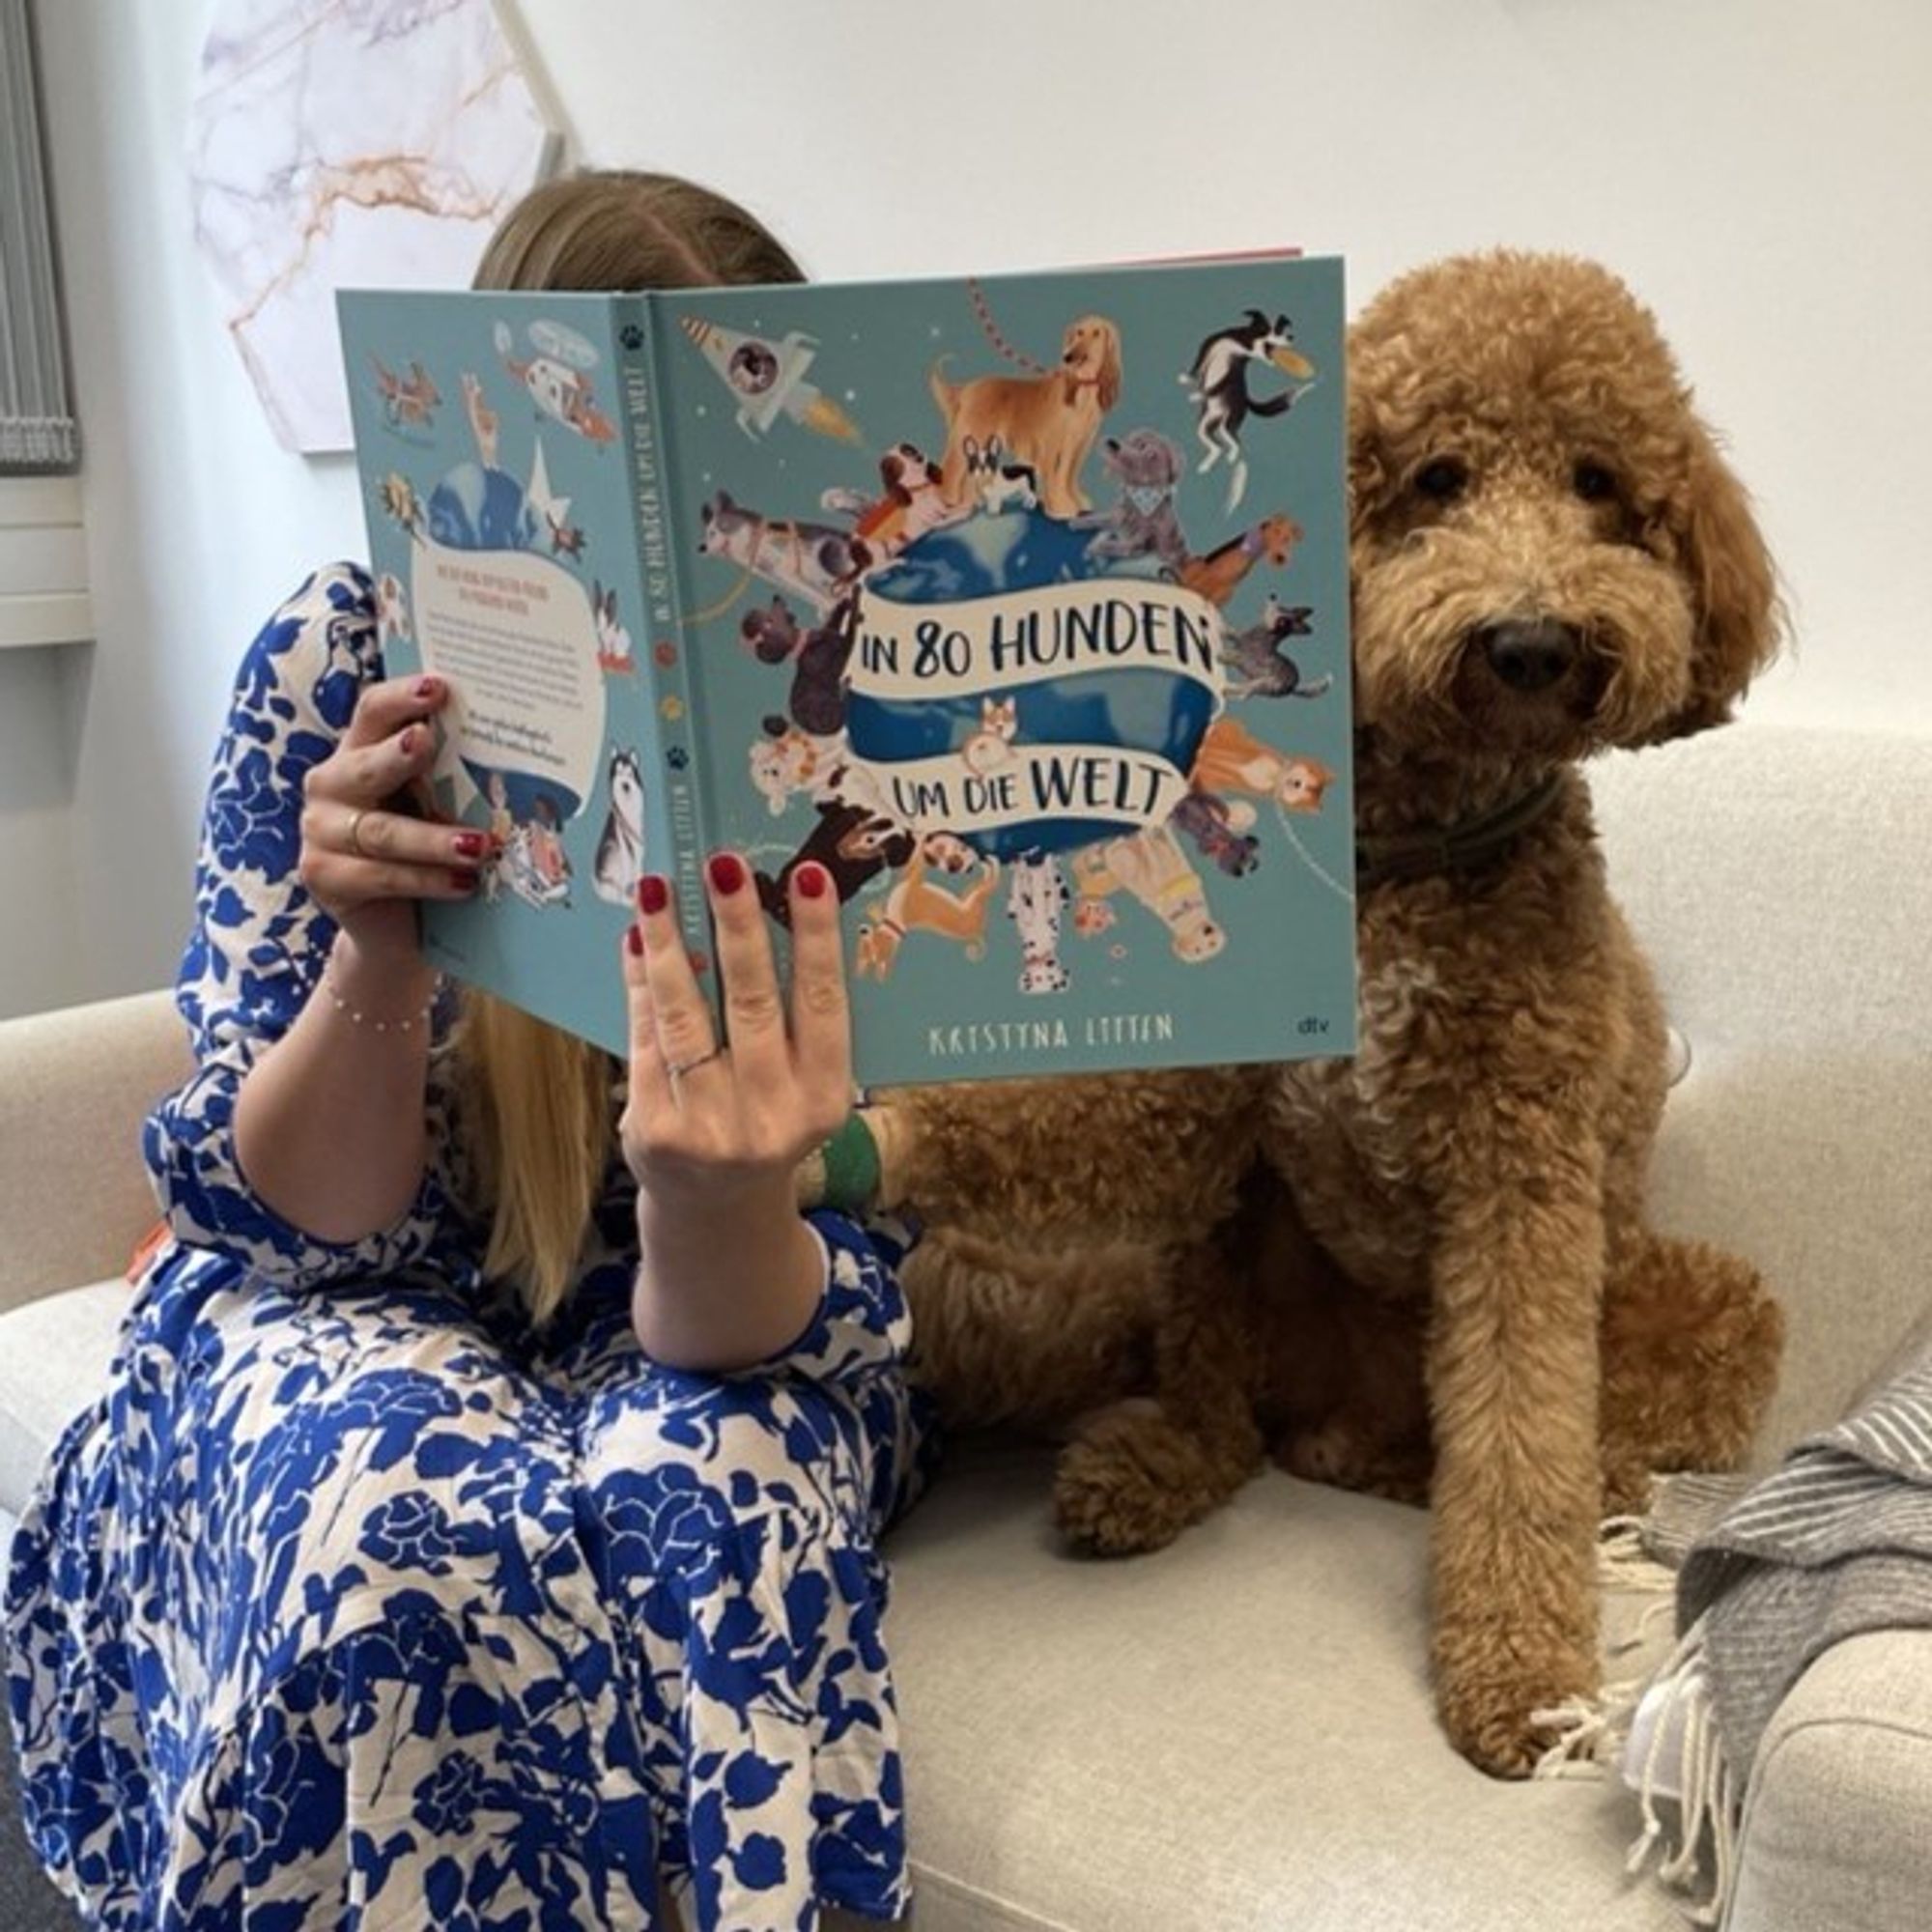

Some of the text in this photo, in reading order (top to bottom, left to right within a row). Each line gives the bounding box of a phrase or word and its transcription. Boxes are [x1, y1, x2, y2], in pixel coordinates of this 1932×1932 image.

[861, 600, 1213, 677] IN 80 HUNDEN
[893, 756, 1173, 818] UM DIE WELT
[927, 1013, 1174, 1056] KRISTYNA LITTEN
[1297, 1016, 1330, 1036] dtv
